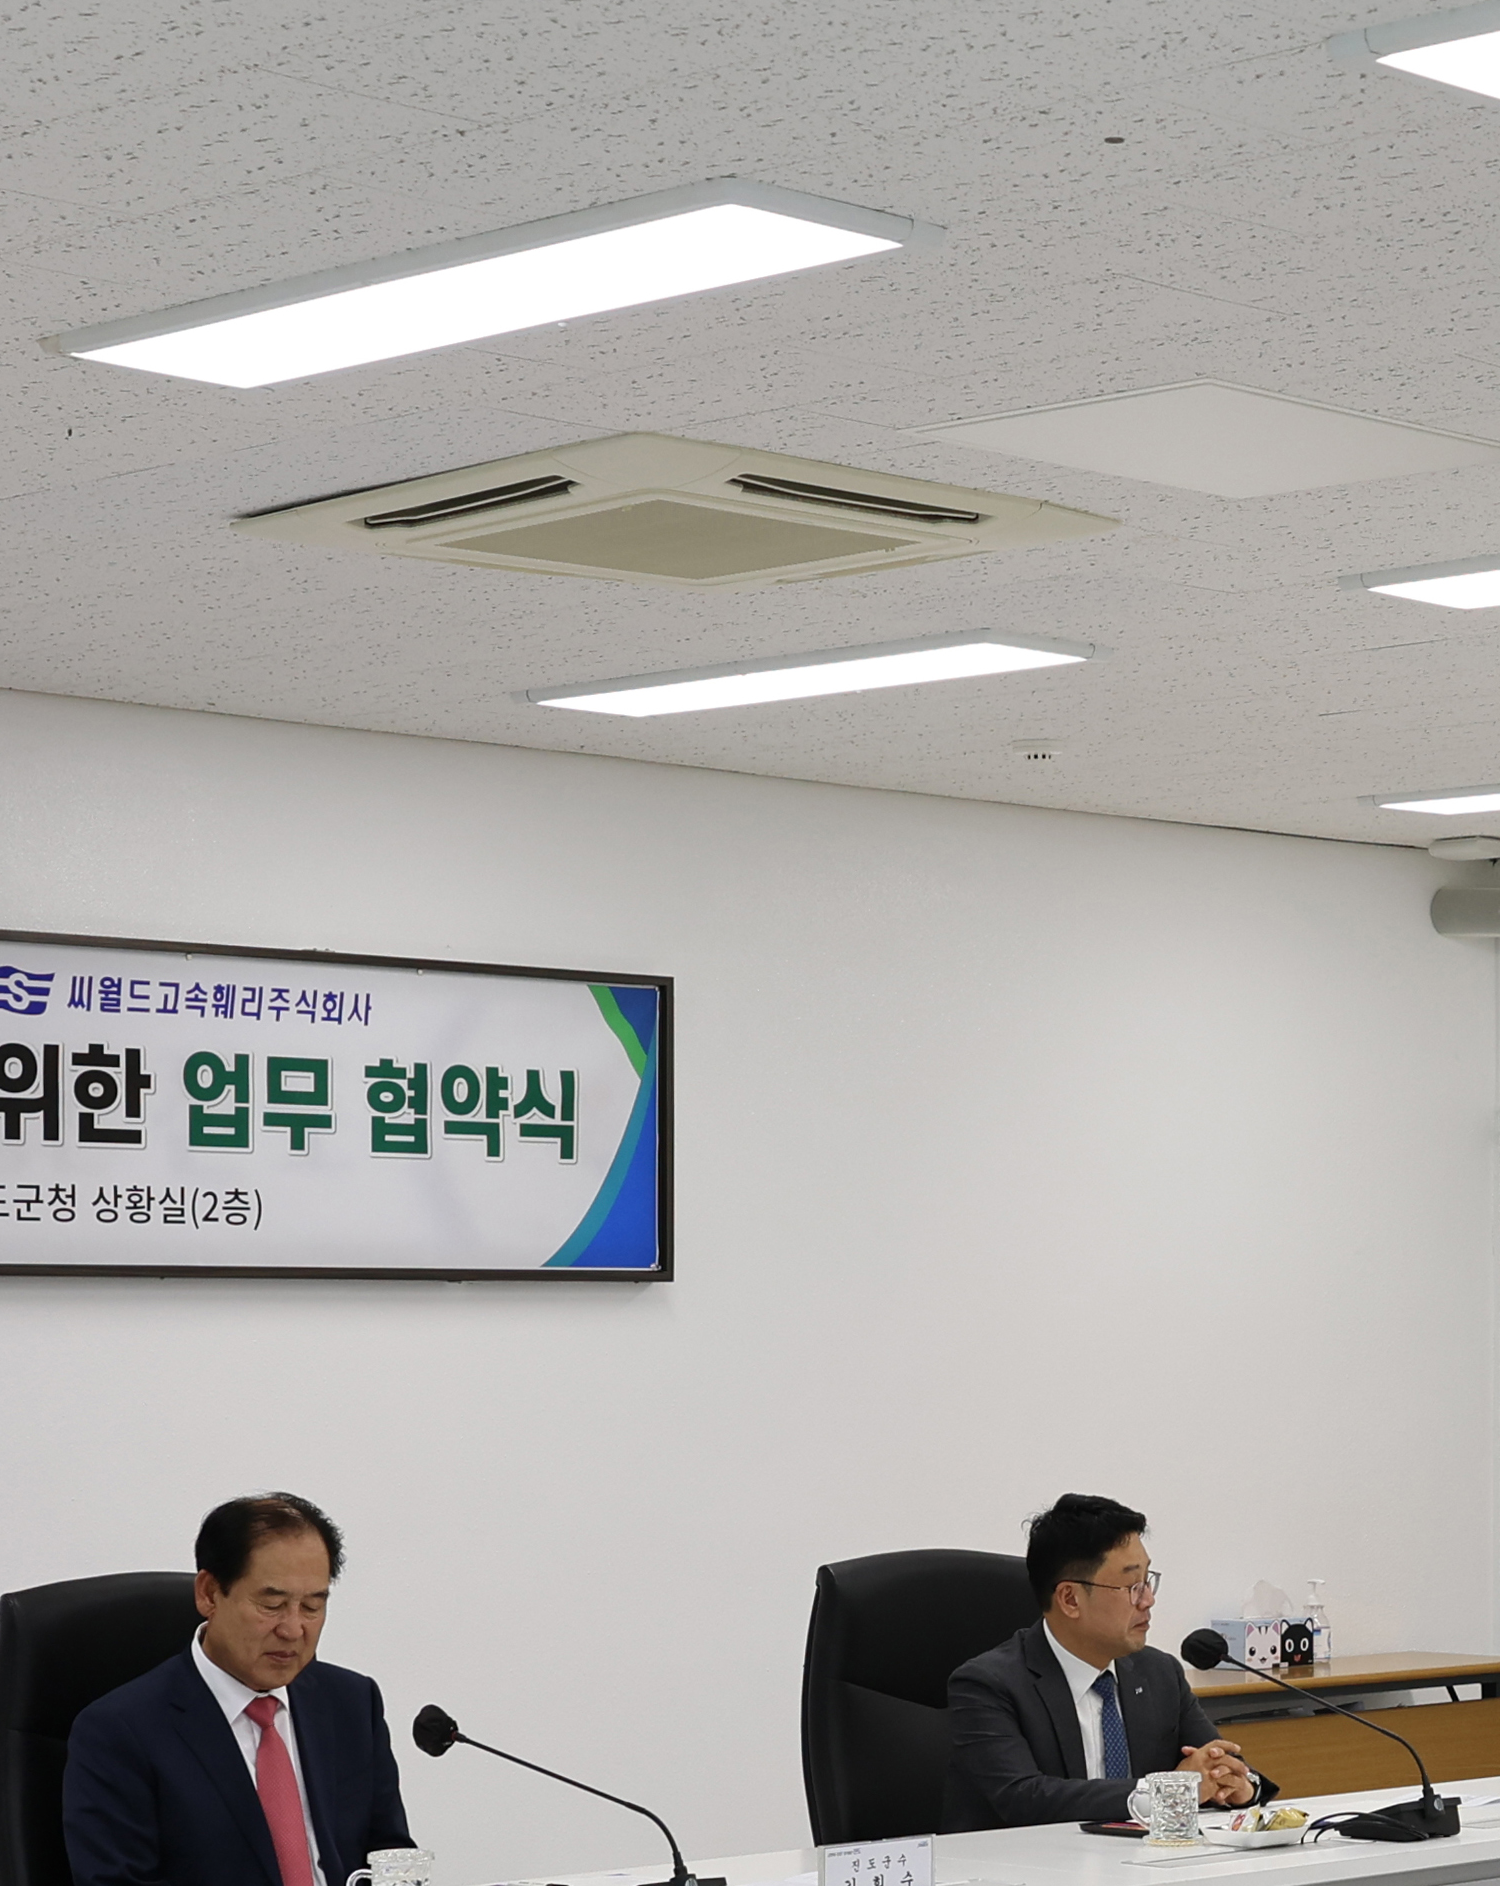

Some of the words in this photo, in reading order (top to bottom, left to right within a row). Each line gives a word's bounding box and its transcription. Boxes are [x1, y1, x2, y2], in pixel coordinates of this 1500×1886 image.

[68, 976, 371, 1026] 씨월드고속훼리주식회사
[183, 1052, 332, 1155] 업무
[365, 1059, 575, 1159] 협약식
[92, 1185, 261, 1230] 상황실(2층)
